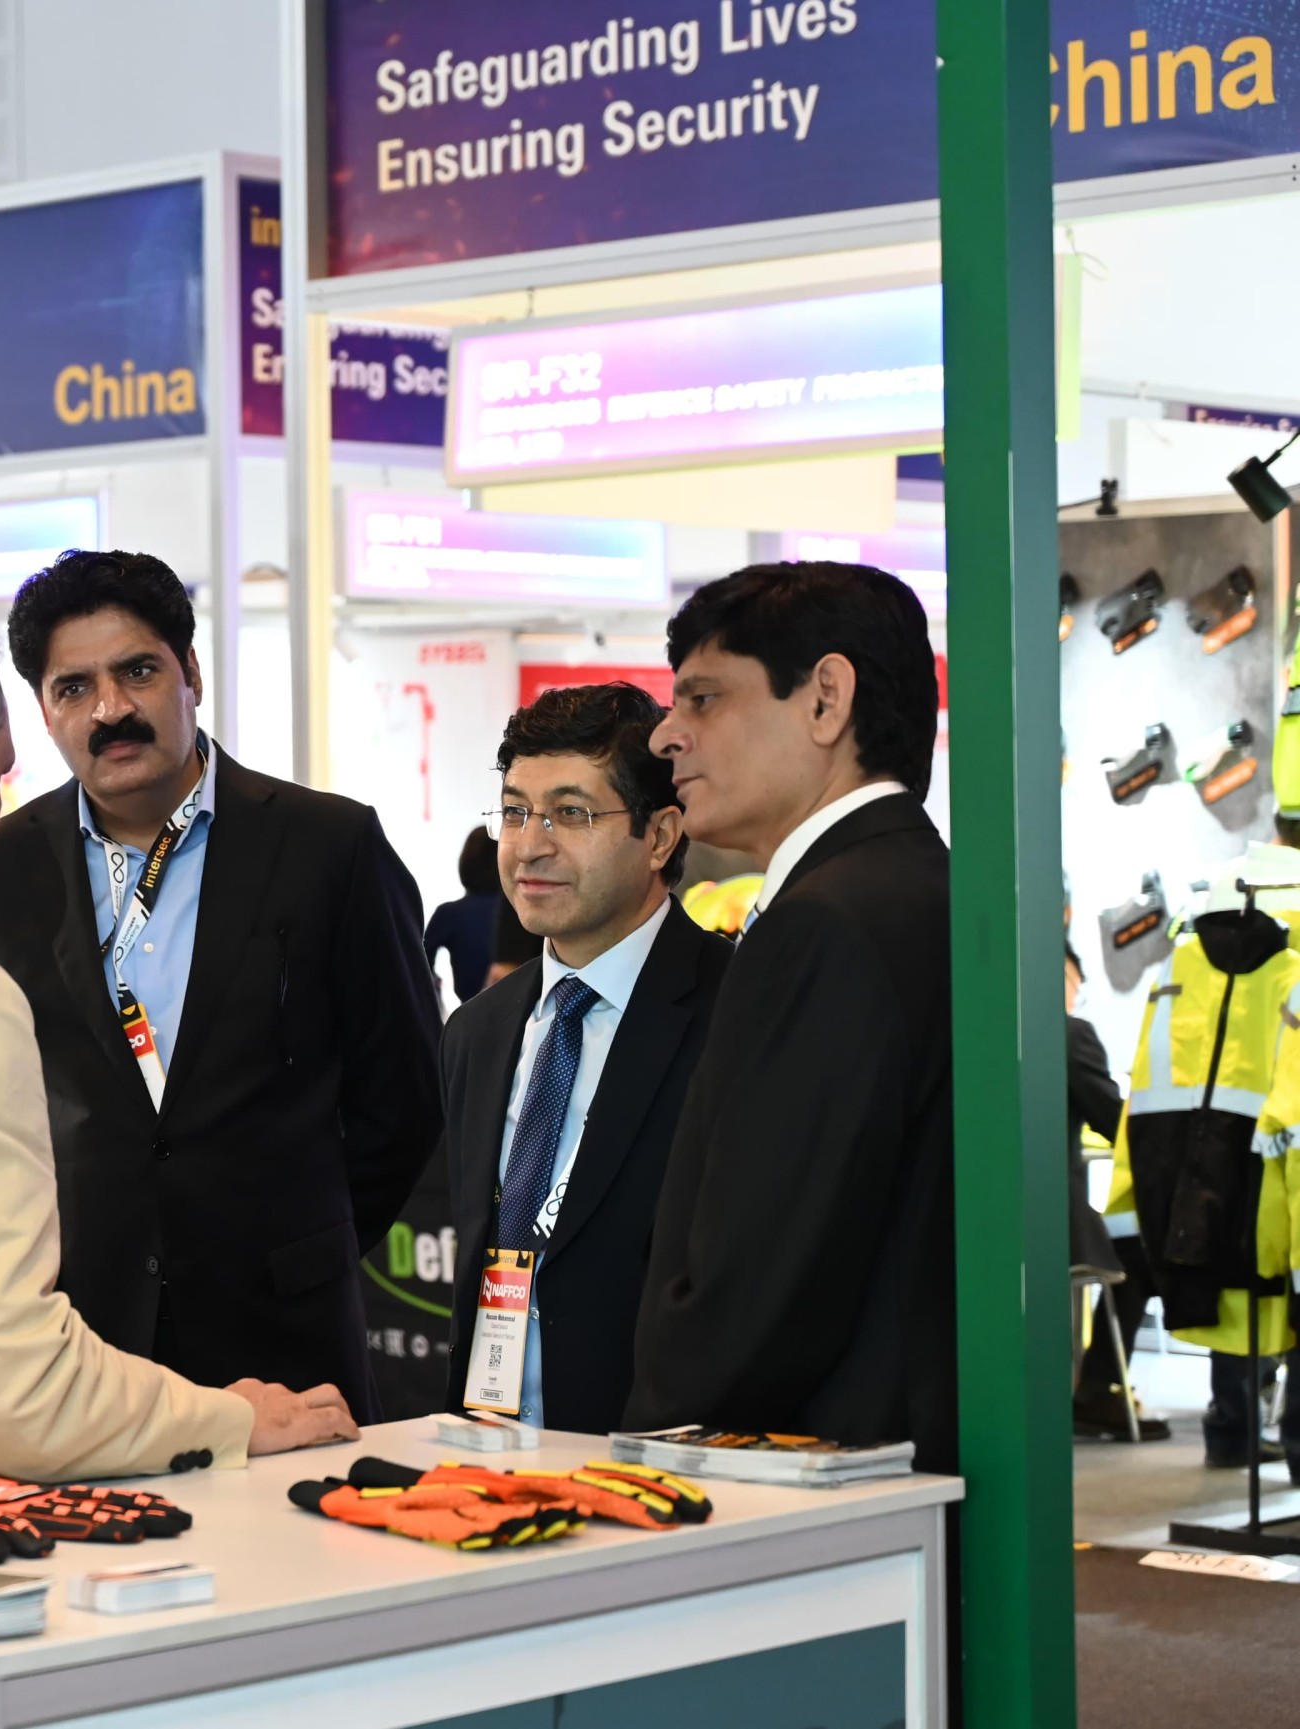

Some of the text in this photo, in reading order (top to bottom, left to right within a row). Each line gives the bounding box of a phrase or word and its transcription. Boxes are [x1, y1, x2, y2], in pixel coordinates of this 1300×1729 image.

[376, 0, 858, 113] Safeguarding Lives
[1050, 30, 1276, 132] hina
[378, 77, 820, 192] Ensuring Security
[54, 358, 197, 426] China
[142, 837, 172, 888] intersec
[125, 924, 140, 946] Parking
[492, 1283, 527, 1299] NAFFCO
